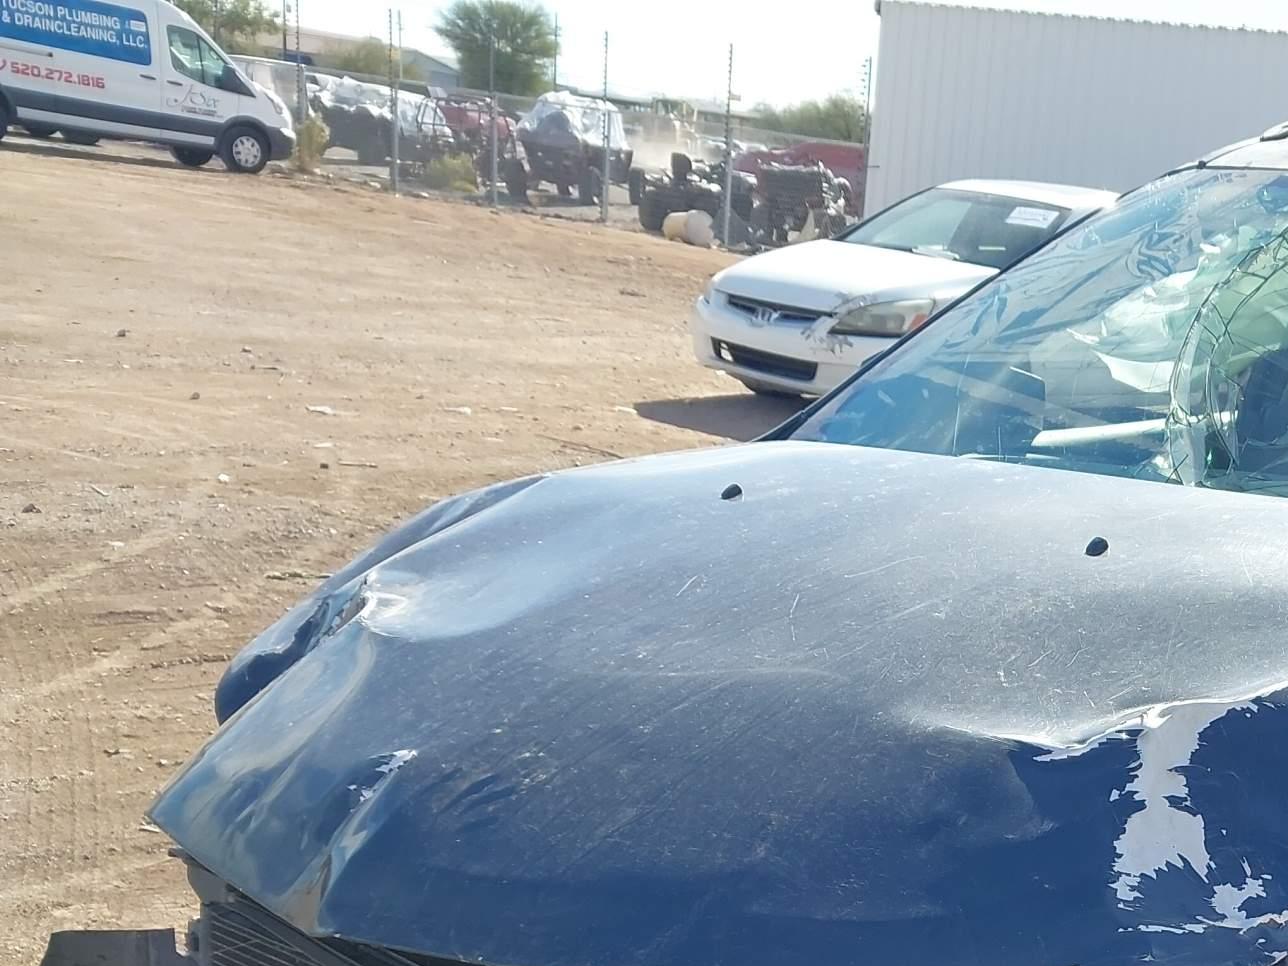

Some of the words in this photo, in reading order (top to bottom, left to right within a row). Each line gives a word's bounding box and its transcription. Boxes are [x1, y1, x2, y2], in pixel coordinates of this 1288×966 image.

[1, 10, 11, 23] &
[2, 0, 54, 17] TUCSON
[57, 6, 121, 29] PLUMBING
[10, 61, 105, 89] 520.272.1816
